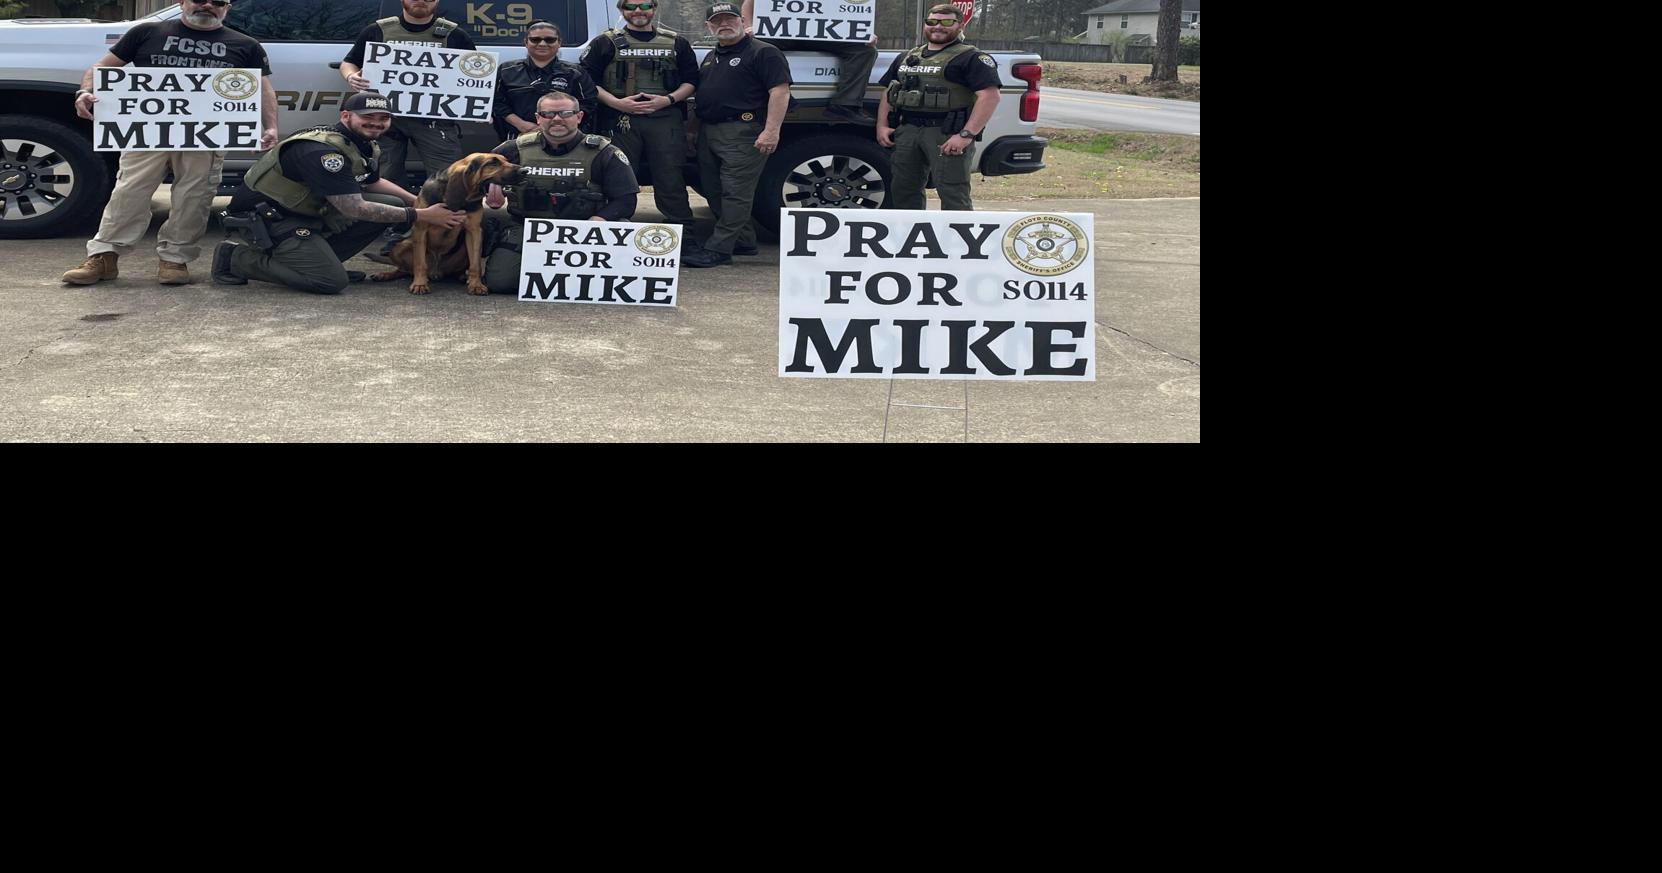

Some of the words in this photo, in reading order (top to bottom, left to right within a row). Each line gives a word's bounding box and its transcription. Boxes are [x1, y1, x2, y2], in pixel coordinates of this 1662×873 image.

[466, 3, 533, 25] K-9
[770, 0, 824, 14] FOR
[755, 16, 872, 40] MIKE
[163, 35, 227, 57] FCSO
[366, 43, 460, 69] PRAY
[620, 48, 672, 56] SHERIFF
[97, 68, 211, 92] PRAY
[380, 69, 440, 88] FOR
[899, 65, 942, 74] SHERIFF
[118, 98, 192, 115] FOR
[97, 121, 258, 149] MIKE
[525, 166, 585, 177] SHERIFF
[526, 219, 634, 246] PRAY
[1043, 216, 1071, 227] COUNTY
[786, 210, 1000, 260] PRAY
[543, 249, 613, 269] FOR
[1052, 261, 1075, 273] OFFICE
[521, 271, 675, 304] MIKE
[824, 270, 963, 306] FOR
[784, 317, 1088, 376] MIKE
